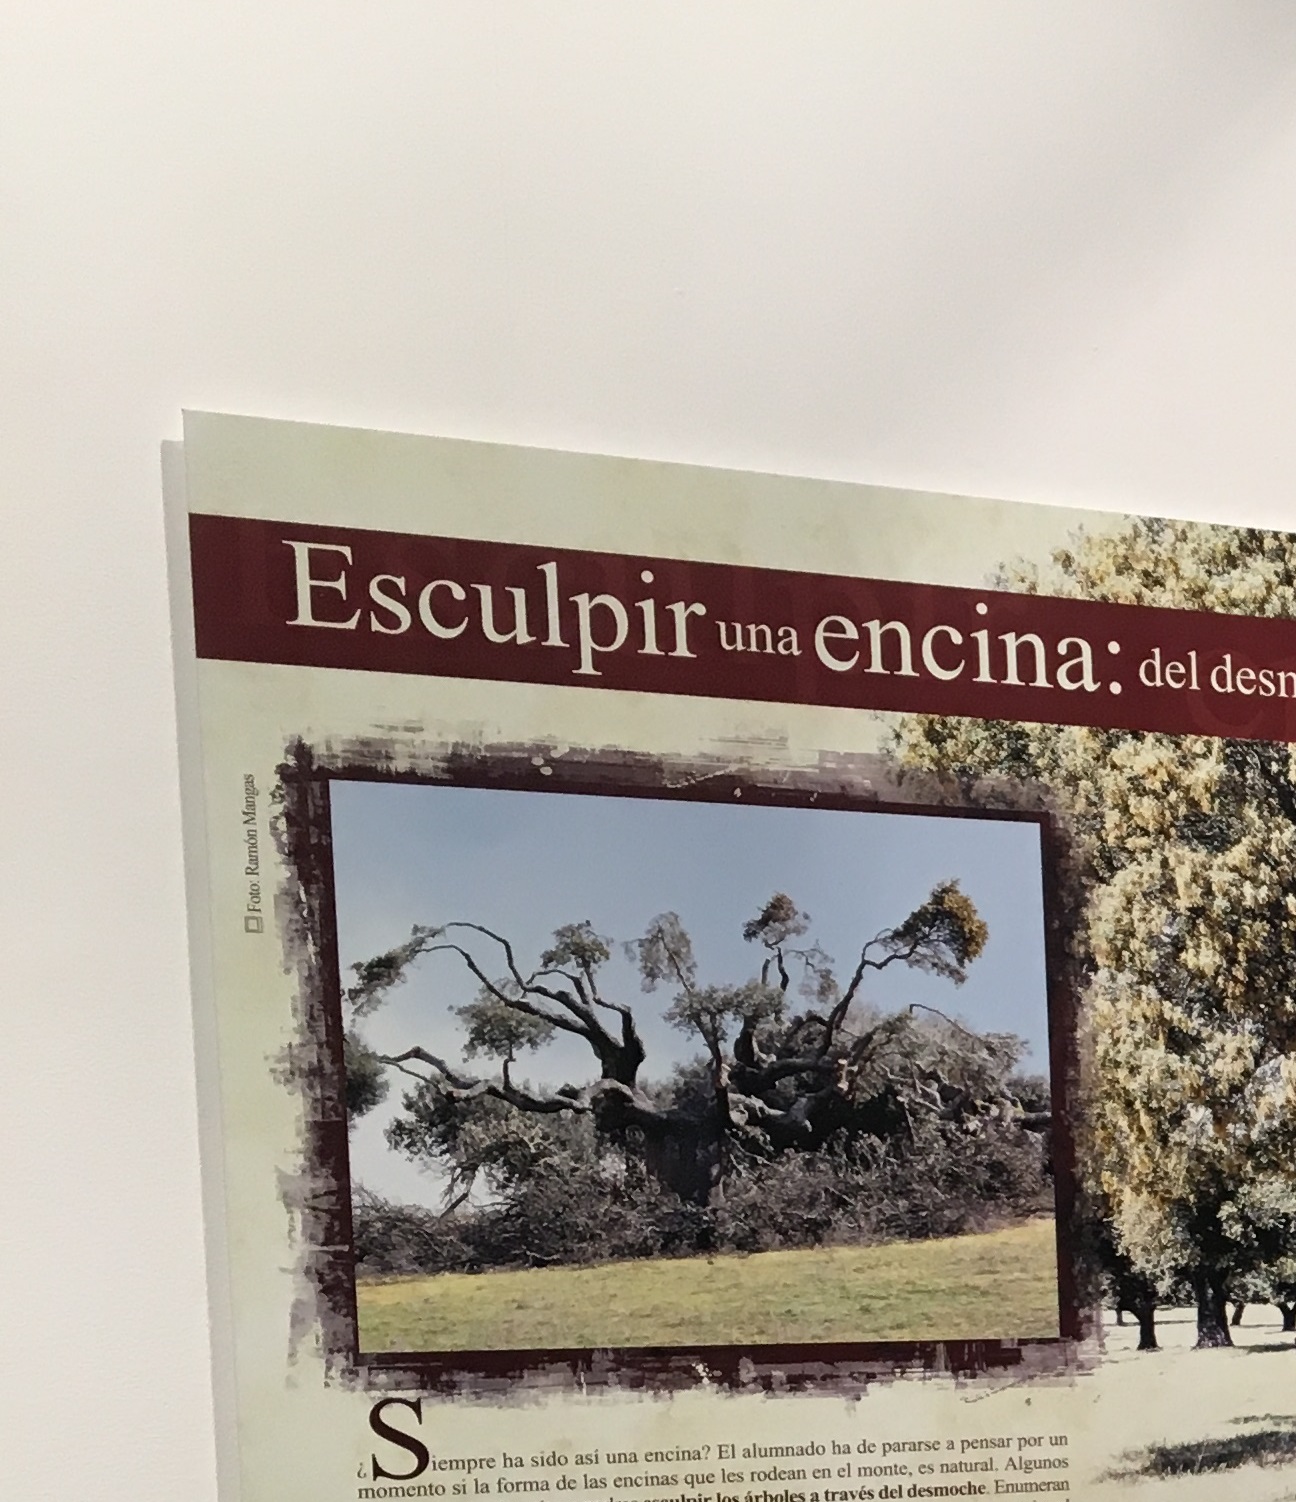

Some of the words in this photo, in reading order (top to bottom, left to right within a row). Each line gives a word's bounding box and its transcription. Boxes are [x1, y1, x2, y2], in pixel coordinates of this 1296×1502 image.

[281, 539, 707, 676] Esculpir
[716, 620, 803, 657] una
[814, 602, 1122, 695] encina:
[1138, 647, 1201, 691] del
[241, 773, 259, 826] Mangas
[243, 829, 259, 876] Ramón
[247, 880, 261, 913] Foto:
[502, 1451, 524, 1468] ha
[530, 1450, 568, 1467] sido
[574, 1448, 599, 1465] así
[605, 1451, 639, 1464] una
[644, 1444, 711, 1462] encina?
[716, 1443, 736, 1460] El
[741, 1440, 826, 1459] alumnado
[831, 1439, 851, 1455] ha
[856, 1438, 876, 1454] de
[881, 1440, 941, 1457] pararse
[945, 1439, 955, 1450] a
[960, 1437, 1013, 1454] pensar
[1016, 1435, 1044, 1451] por
[1048, 1435, 1068, 1447] un
[357, 1482, 446, 1499] momento
[451, 1478, 467, 1495] si
[473, 1477, 490, 1494] la
[496, 1476, 550, 1493] forma
[555, 1474, 577, 1491] de
[582, 1473, 607, 1489] las
[613, 1470, 678, 1488] encinas
[683, 1472, 715, 1489] que
[720, 1467, 744, 1484] les
[750, 1465, 807, 1482] rodean
[811, 1467, 832, 1479] en
[837, 1462, 851, 1478] el
[857, 1463, 913, 1477] monte,
[917, 1463, 934, 1475] es
[939, 1456, 998, 1474] natural.
[1004, 1455, 1069, 1474] Algunos
[809, 1491, 820, 1502] a
[823, 1484, 874, 1502] través
[878, 1483, 903, 1500] del
[993, 1479, 1070, 1494] Enumeran
